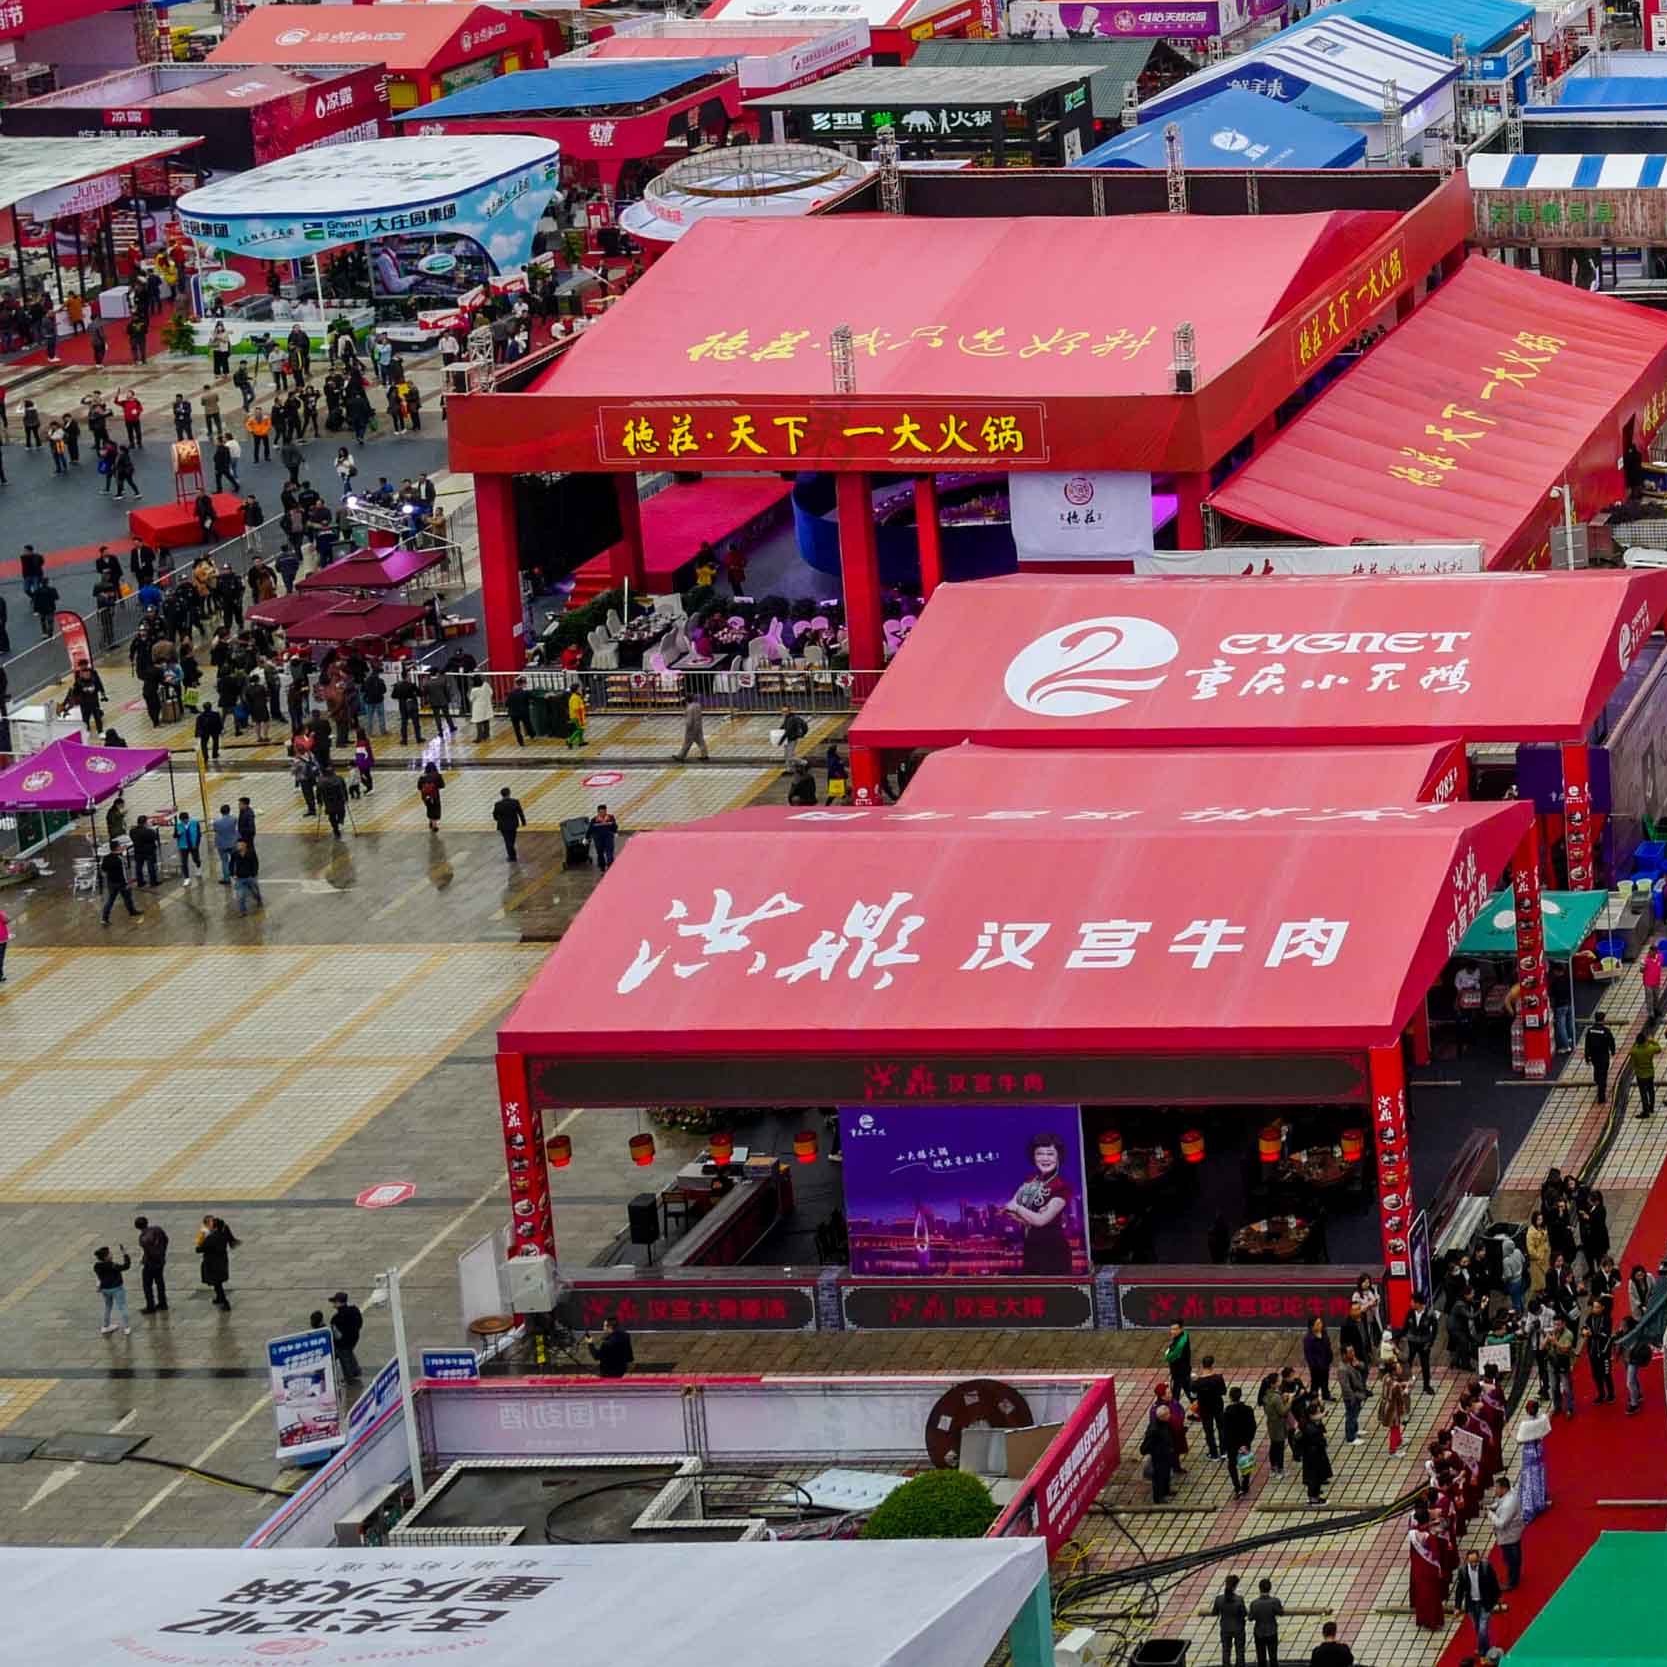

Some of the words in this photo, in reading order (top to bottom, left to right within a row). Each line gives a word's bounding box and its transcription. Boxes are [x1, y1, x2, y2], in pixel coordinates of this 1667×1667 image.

[949, 110, 993, 127] 火锅
[327, 218, 362, 229] Grand
[370, 202, 456, 232] 大庄园集团
[326, 228, 359, 239] Farm
[1219, 630, 1471, 655] CYGNET
[958, 918, 1351, 971] 汉宫牛肉
[948, 1073, 1047, 1093] 汉宫牛肉
[219, 1576, 562, 1605] 重庆火锅
[159, 1605, 511, 1635] 舌尖记忆
